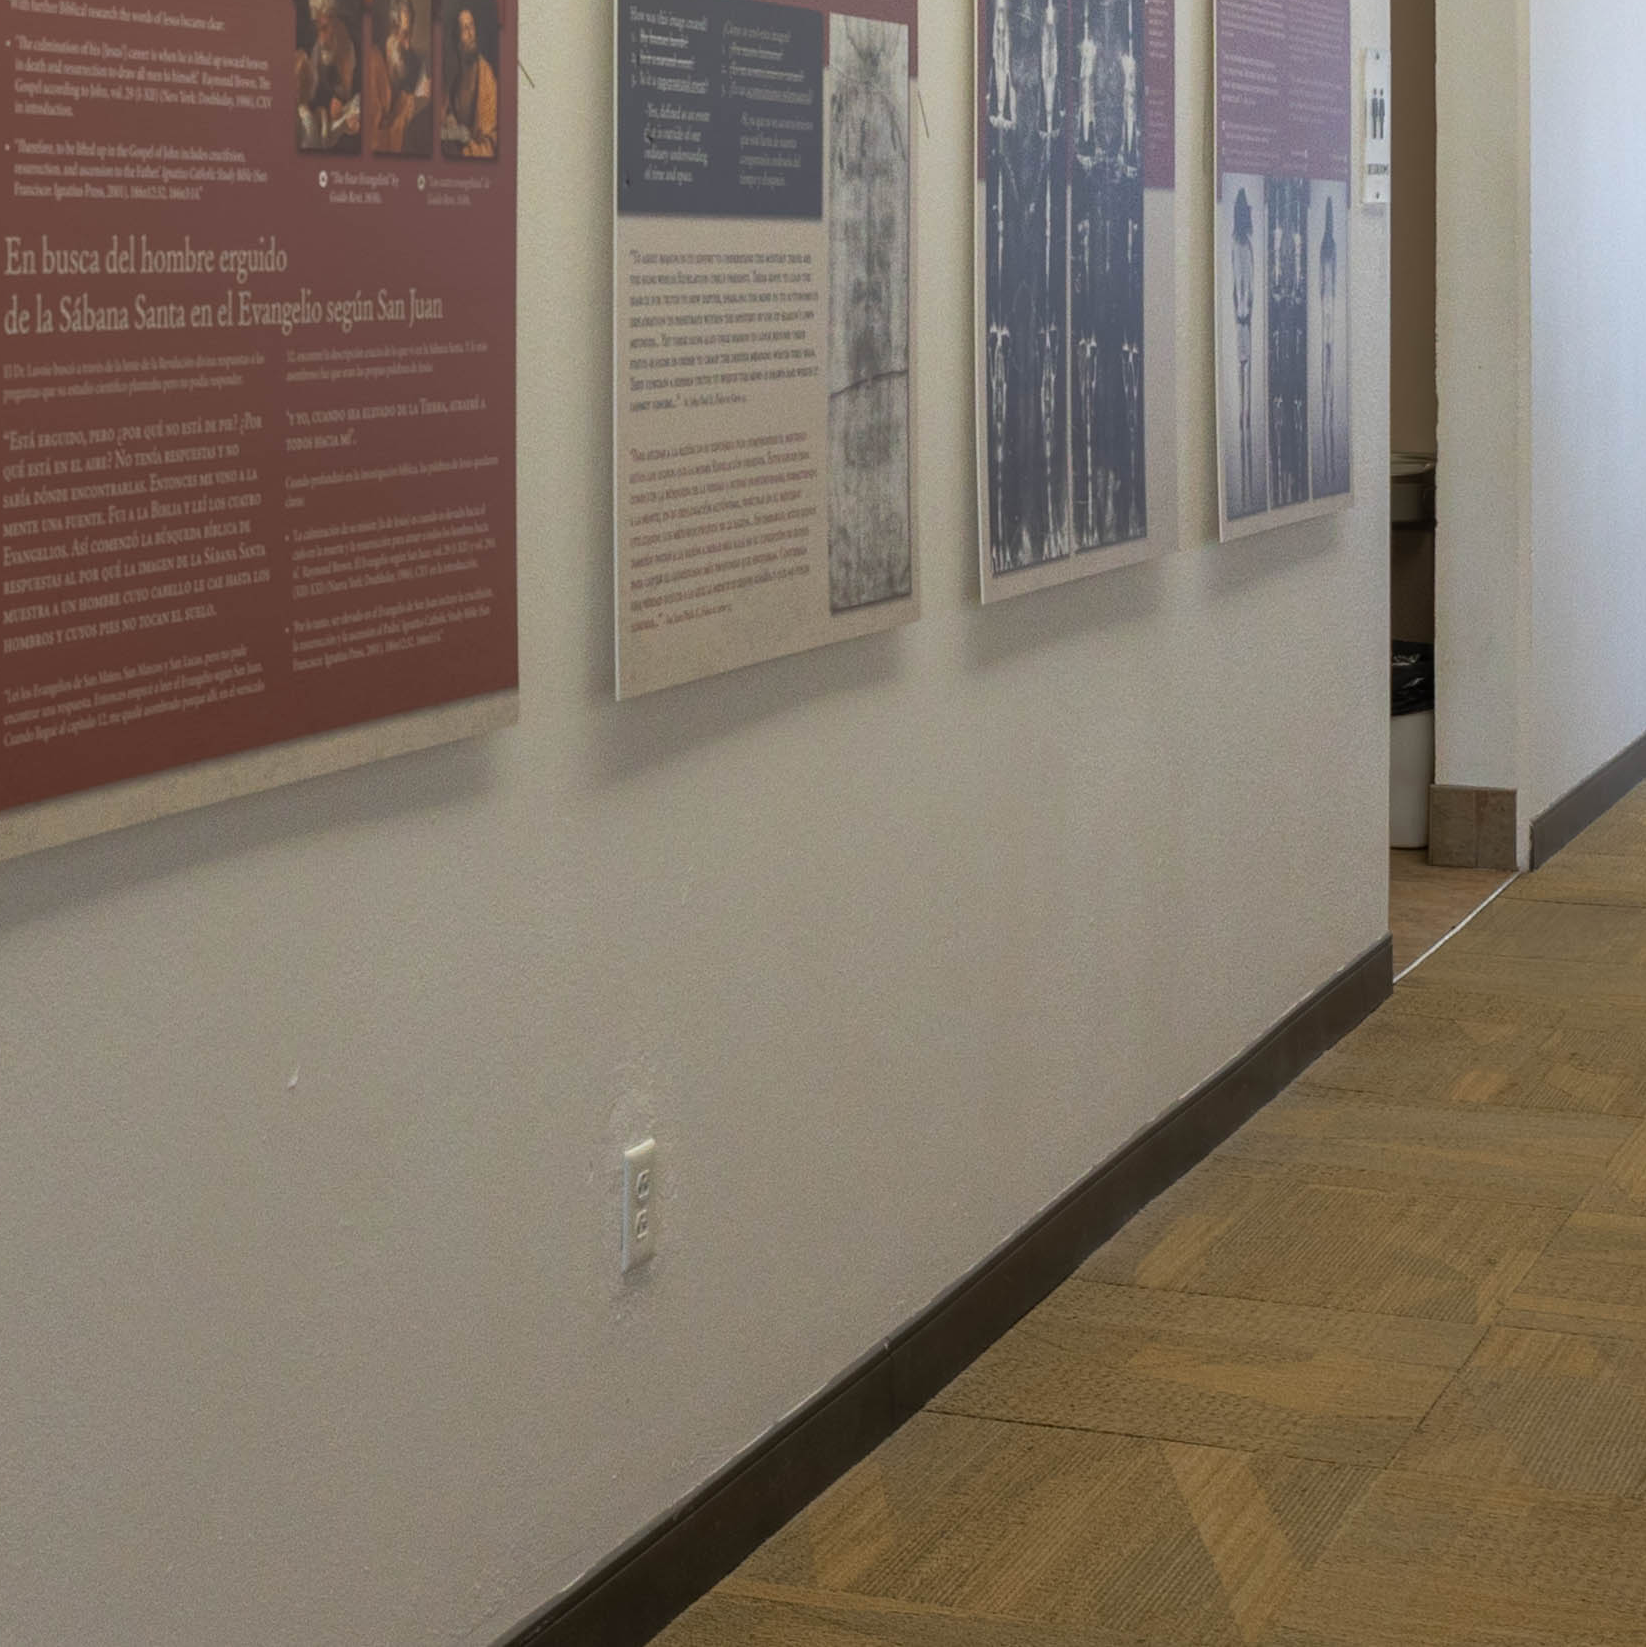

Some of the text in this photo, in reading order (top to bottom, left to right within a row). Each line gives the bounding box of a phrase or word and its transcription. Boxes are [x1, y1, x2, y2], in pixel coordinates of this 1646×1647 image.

[3, 233, 288, 284] En busca del hombre erguido
[2, 286, 443, 337] de la Sábana Santa en el Evangelio según San Juan
